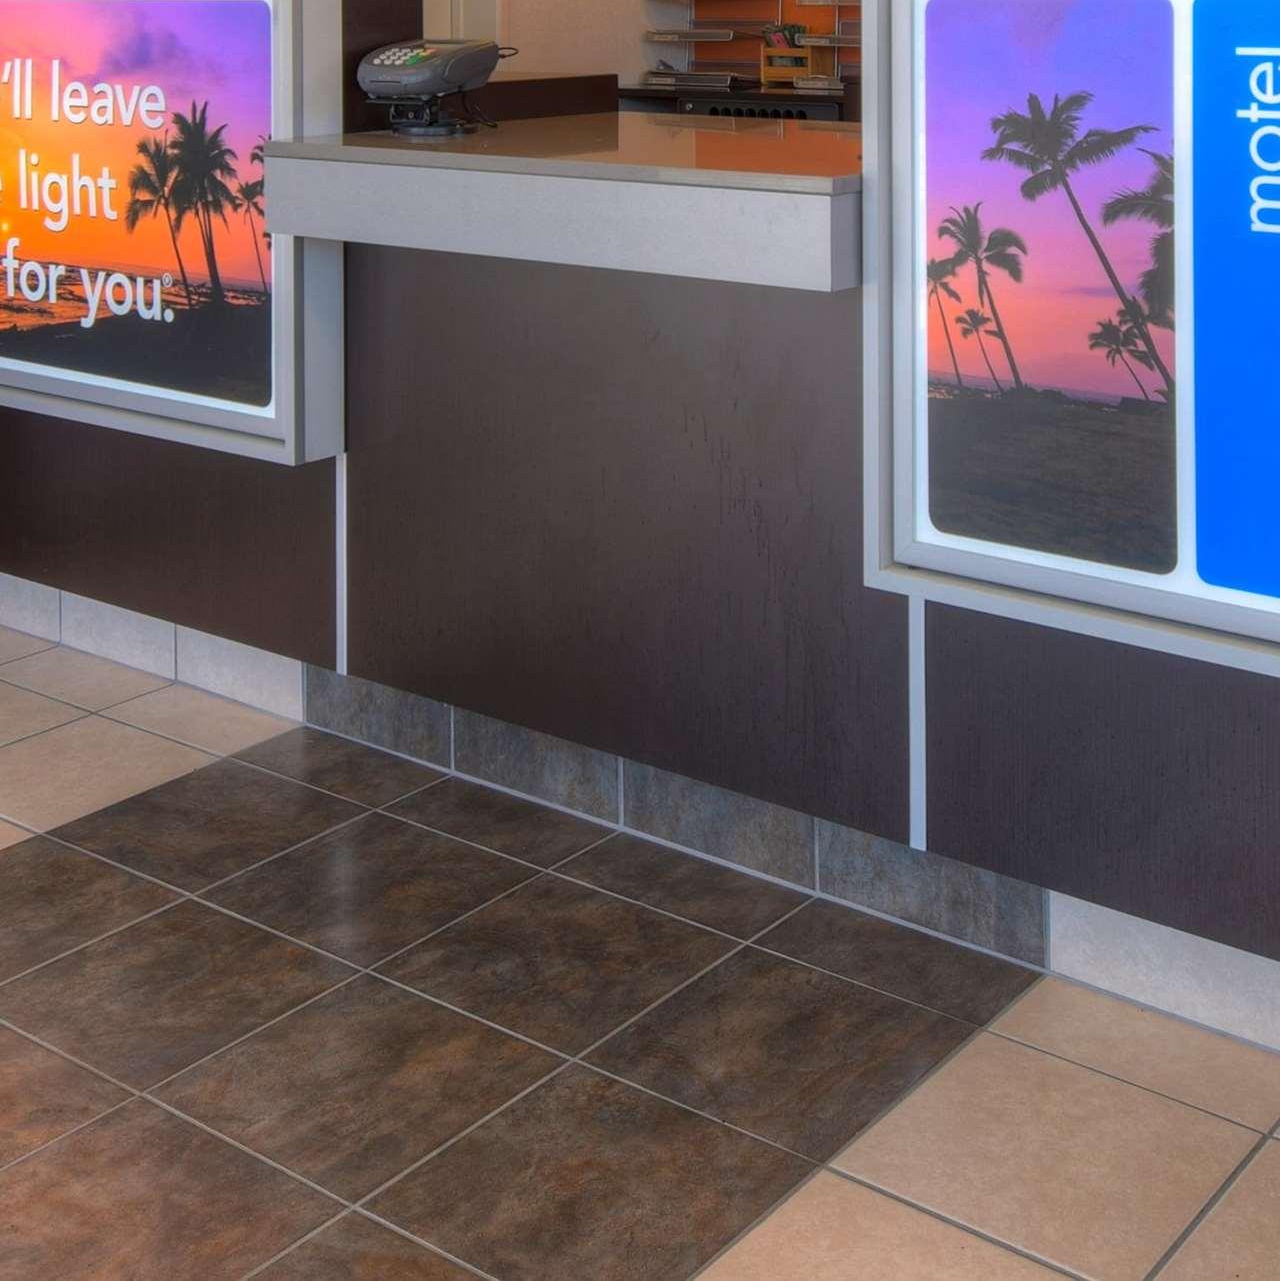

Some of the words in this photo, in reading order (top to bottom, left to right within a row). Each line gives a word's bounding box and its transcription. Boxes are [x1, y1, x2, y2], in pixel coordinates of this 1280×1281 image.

[51, 59, 166, 128] leave
[19, 148, 118, 232] light
[4, 238, 64, 303] for
